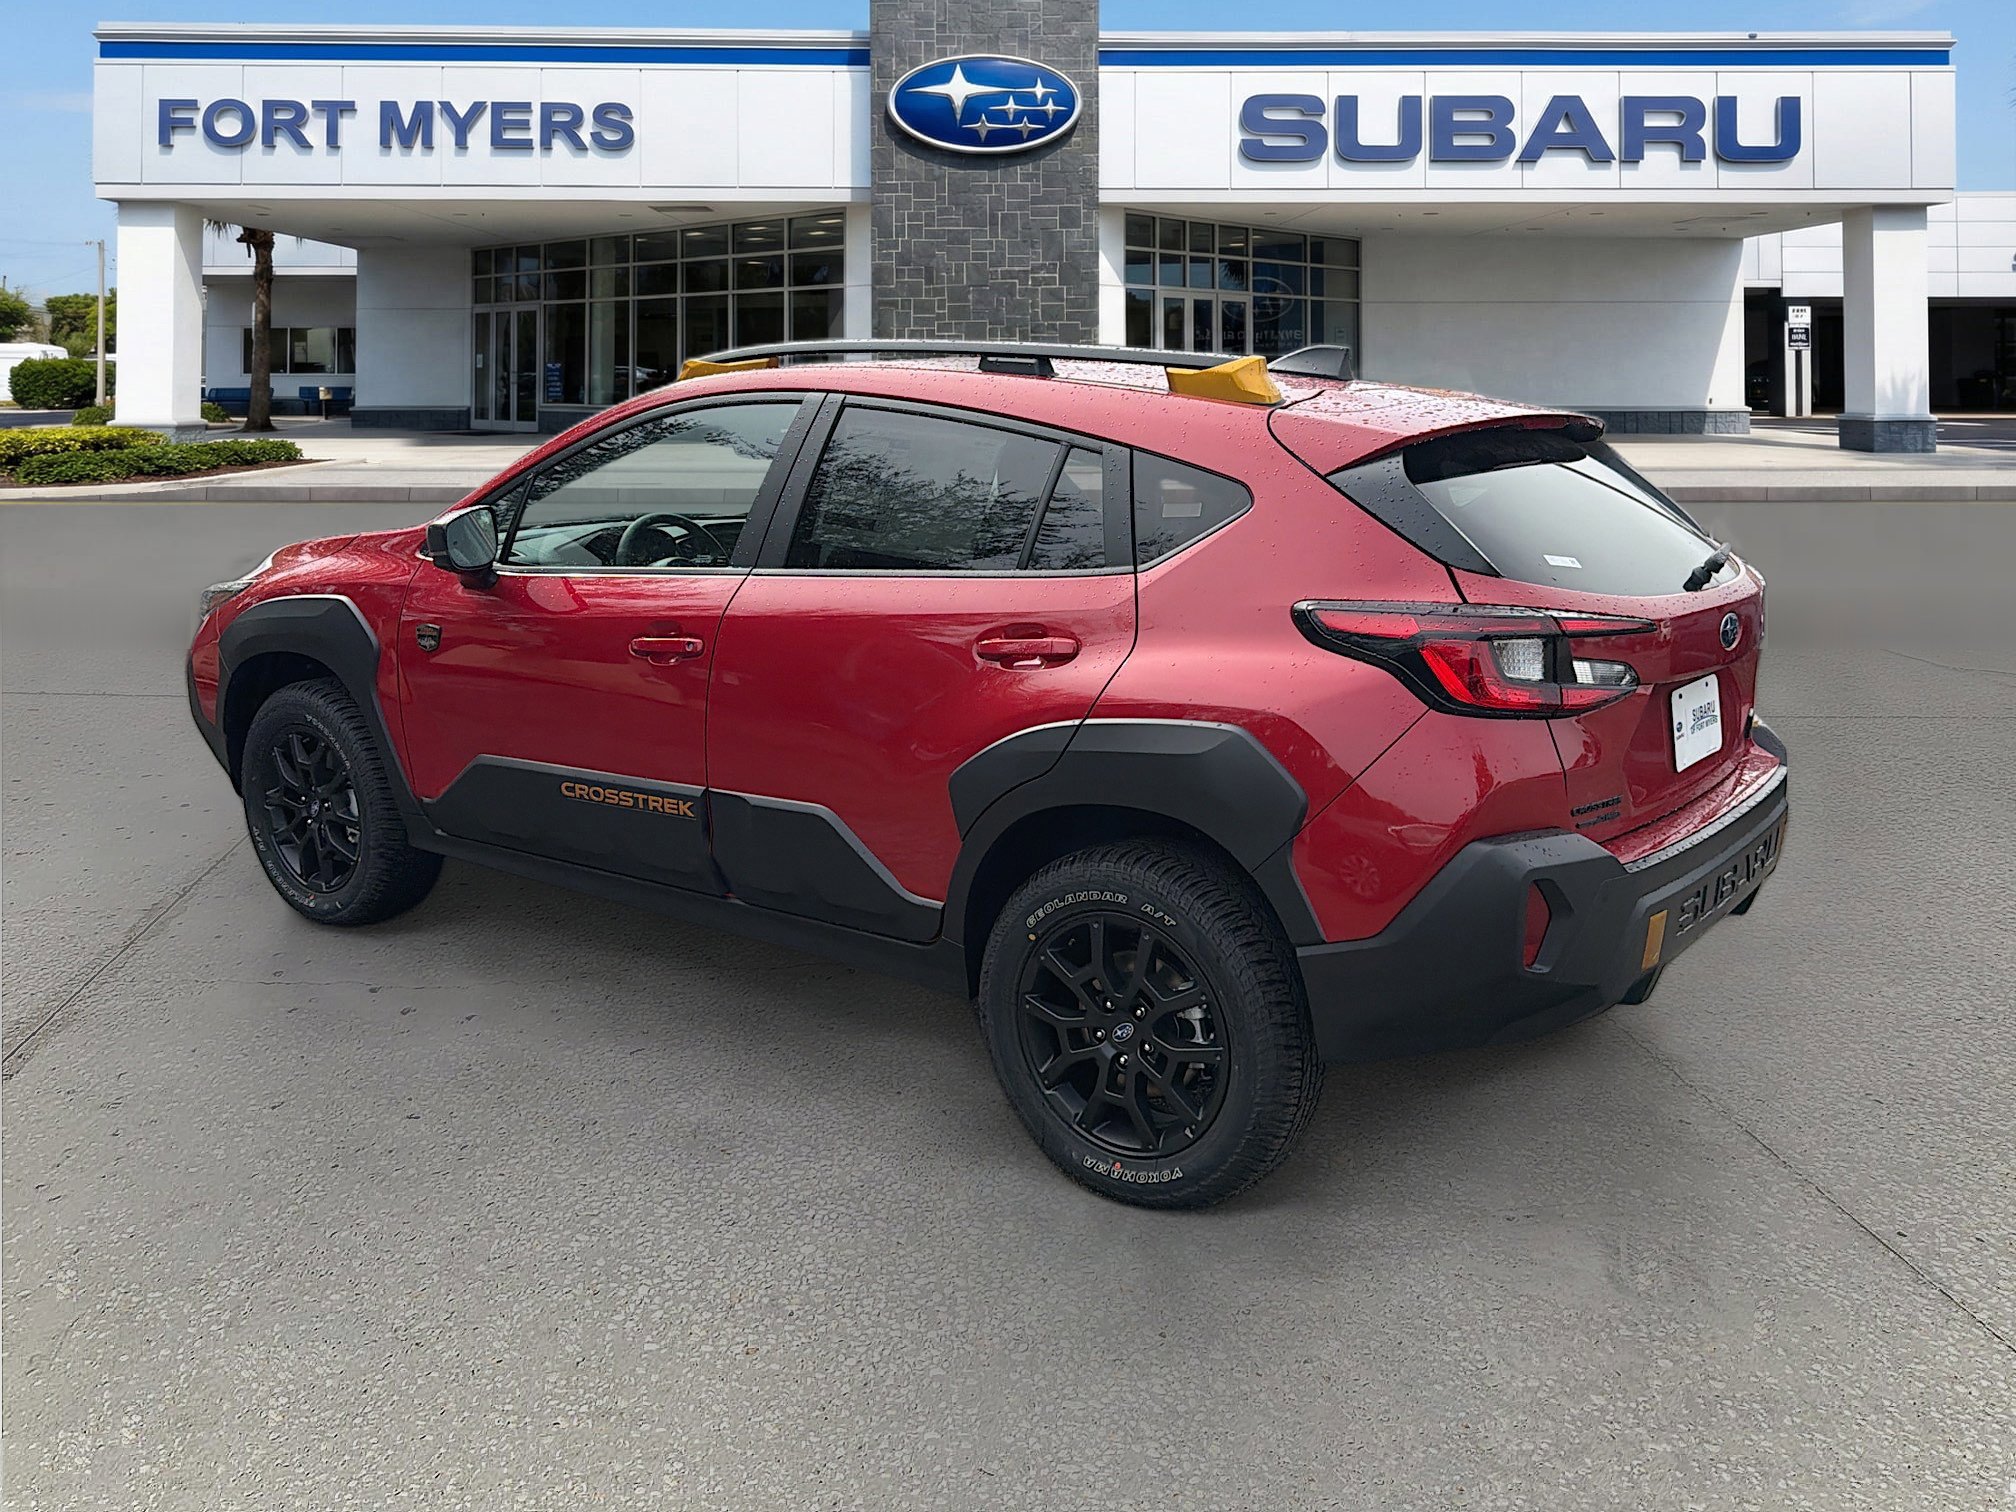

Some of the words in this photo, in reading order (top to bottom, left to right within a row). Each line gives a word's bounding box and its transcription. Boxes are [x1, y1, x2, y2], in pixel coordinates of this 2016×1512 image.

[158, 98, 357, 148] FORT
[379, 100, 634, 151] MYERS
[1240, 93, 1801, 163] SUBARU
[1692, 700, 1715, 722] SUBARU
[560, 781, 695, 818] CROSSTREK
[1676, 827, 1780, 937] SUBARU
[1026, 890, 1129, 929] GEOLANDAR
[1140, 903, 1177, 927] A/T
[1083, 1155, 1183, 1184] YOKOHAMA
